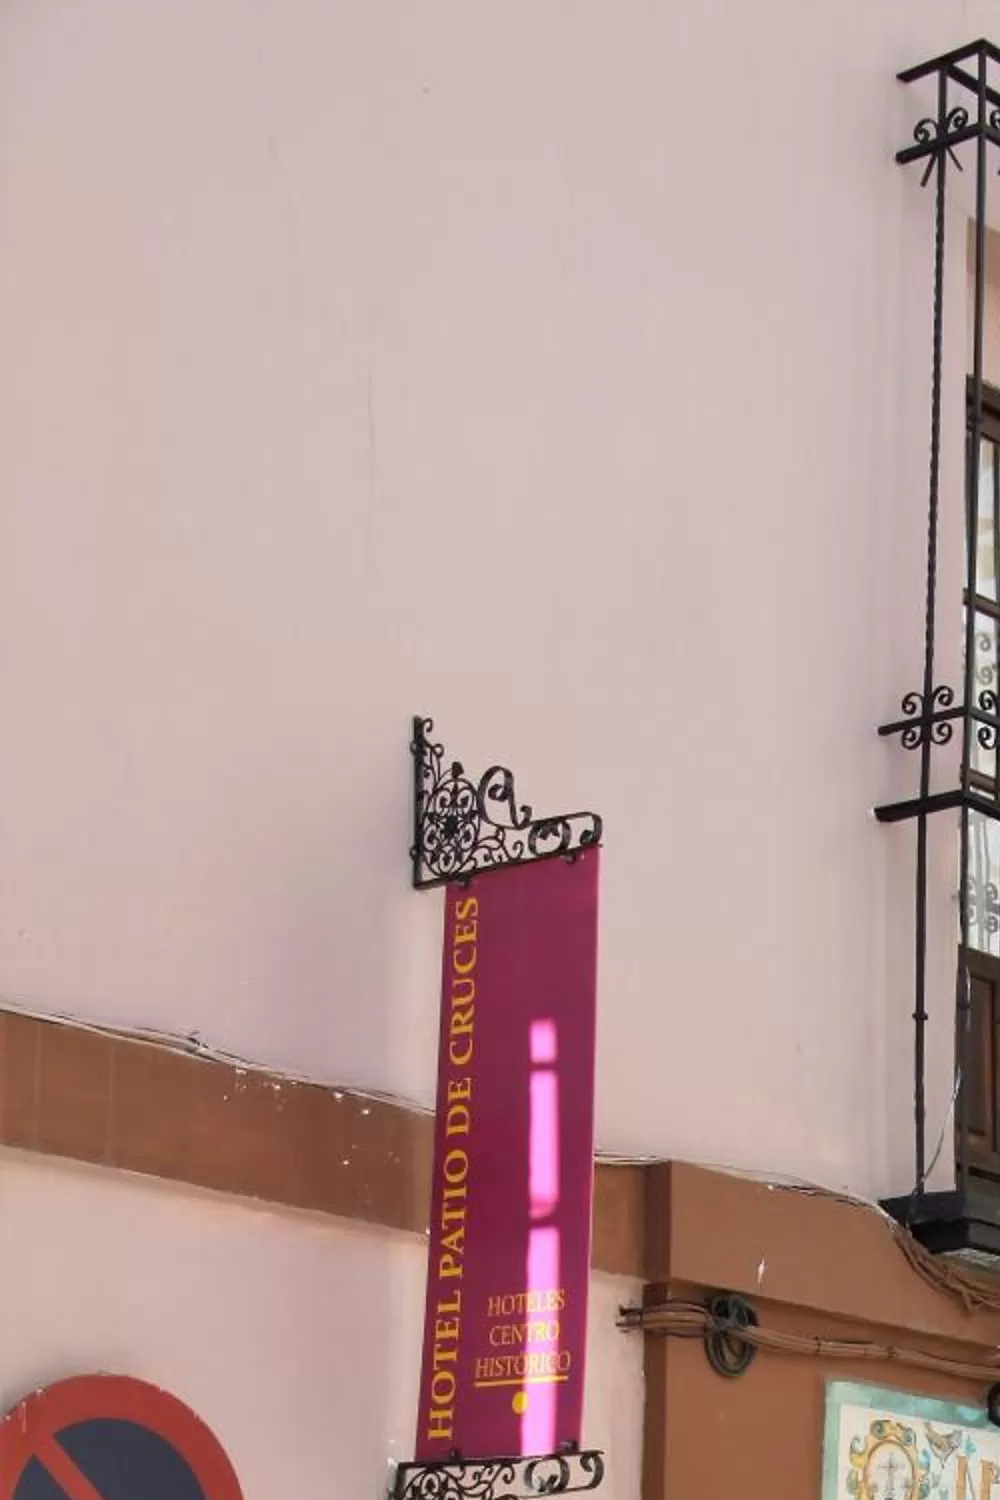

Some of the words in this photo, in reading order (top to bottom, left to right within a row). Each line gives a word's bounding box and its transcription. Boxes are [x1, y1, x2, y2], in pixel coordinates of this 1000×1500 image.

[450, 896, 479, 1065] CRUCES
[446, 1077, 472, 1137] DE
[440, 1149, 468, 1279] PATIO
[487, 1288, 566, 1317] HOTELES
[489, 1320, 561, 1347] CENTRO
[428, 1290, 461, 1440] HOTEL
